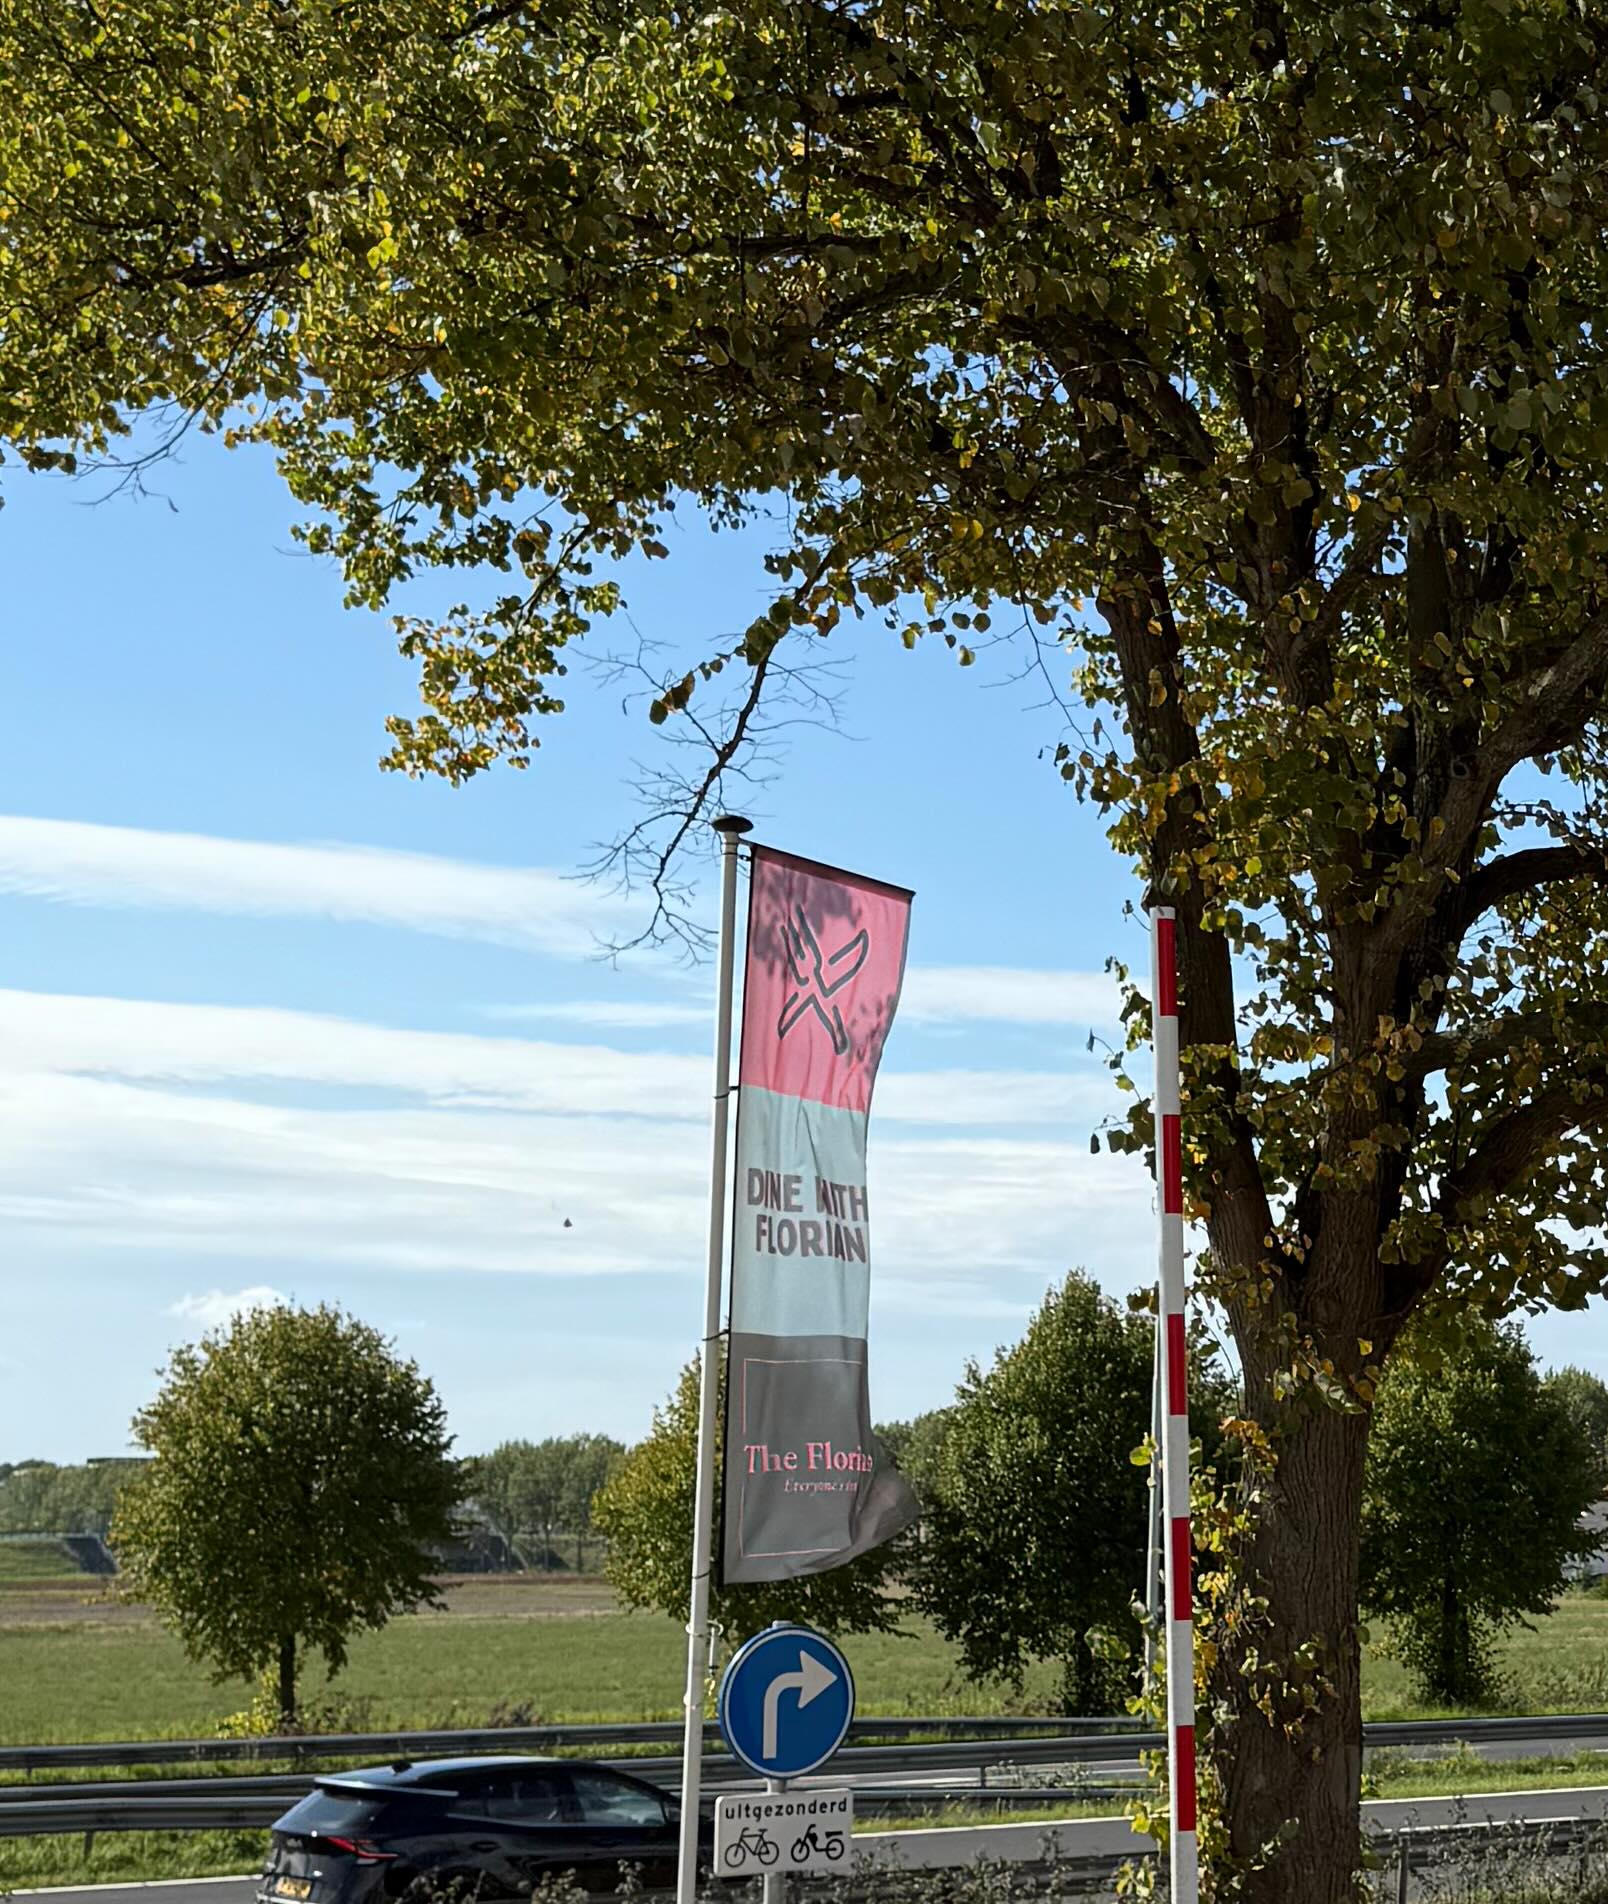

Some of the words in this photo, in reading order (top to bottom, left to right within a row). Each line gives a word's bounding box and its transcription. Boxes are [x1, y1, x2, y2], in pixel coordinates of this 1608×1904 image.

[746, 1167, 804, 1213] DINE
[755, 1214, 866, 1264] FLORIAN
[743, 1443, 798, 1474] The
[725, 1797, 848, 1822] uitgezonderd
